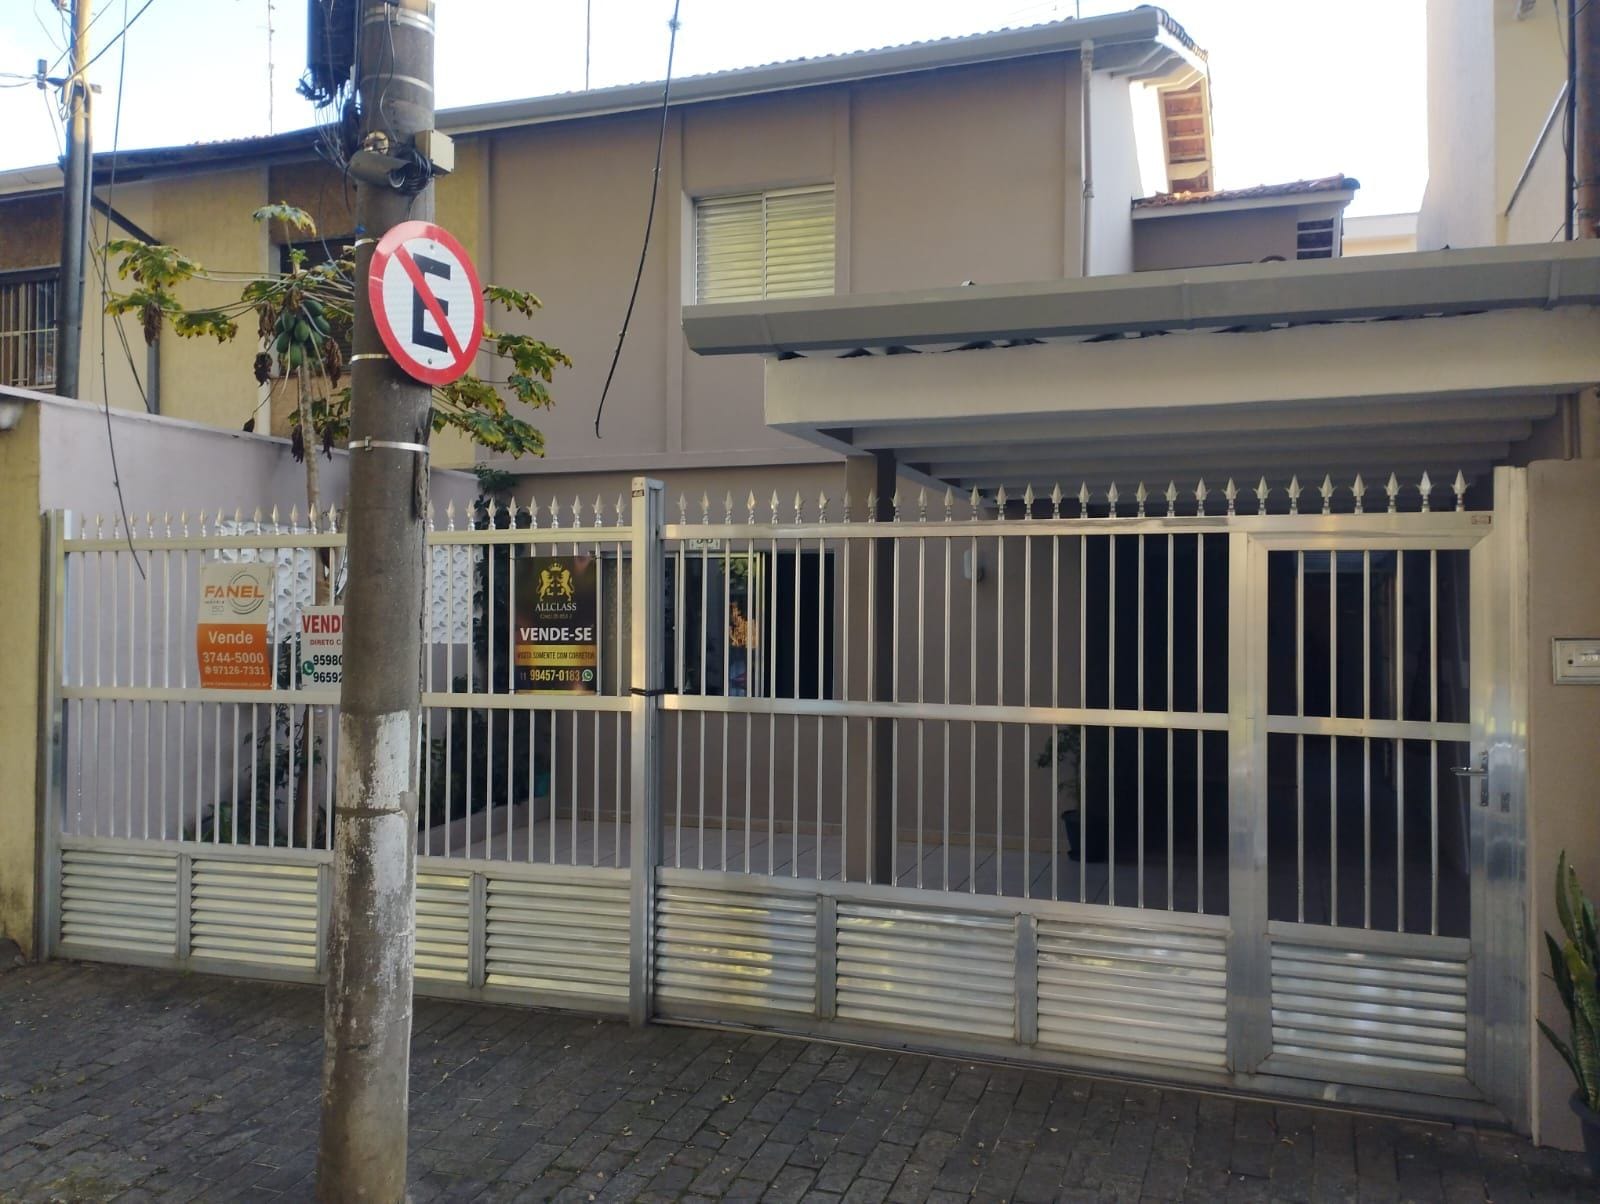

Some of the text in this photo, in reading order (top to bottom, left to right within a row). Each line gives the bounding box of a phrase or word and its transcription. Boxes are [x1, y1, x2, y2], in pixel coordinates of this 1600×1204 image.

[412, 253, 451, 353] E
[204, 585, 265, 598] FANEL
[535, 602, 577, 612] ALLCLASS
[302, 614, 344, 634] VEND
[208, 630, 253, 644] Vende
[520, 627, 592, 641] VENDE-SE
[202, 651, 264, 664] 3744-5000
[530, 669, 580, 681] 99457-0183
